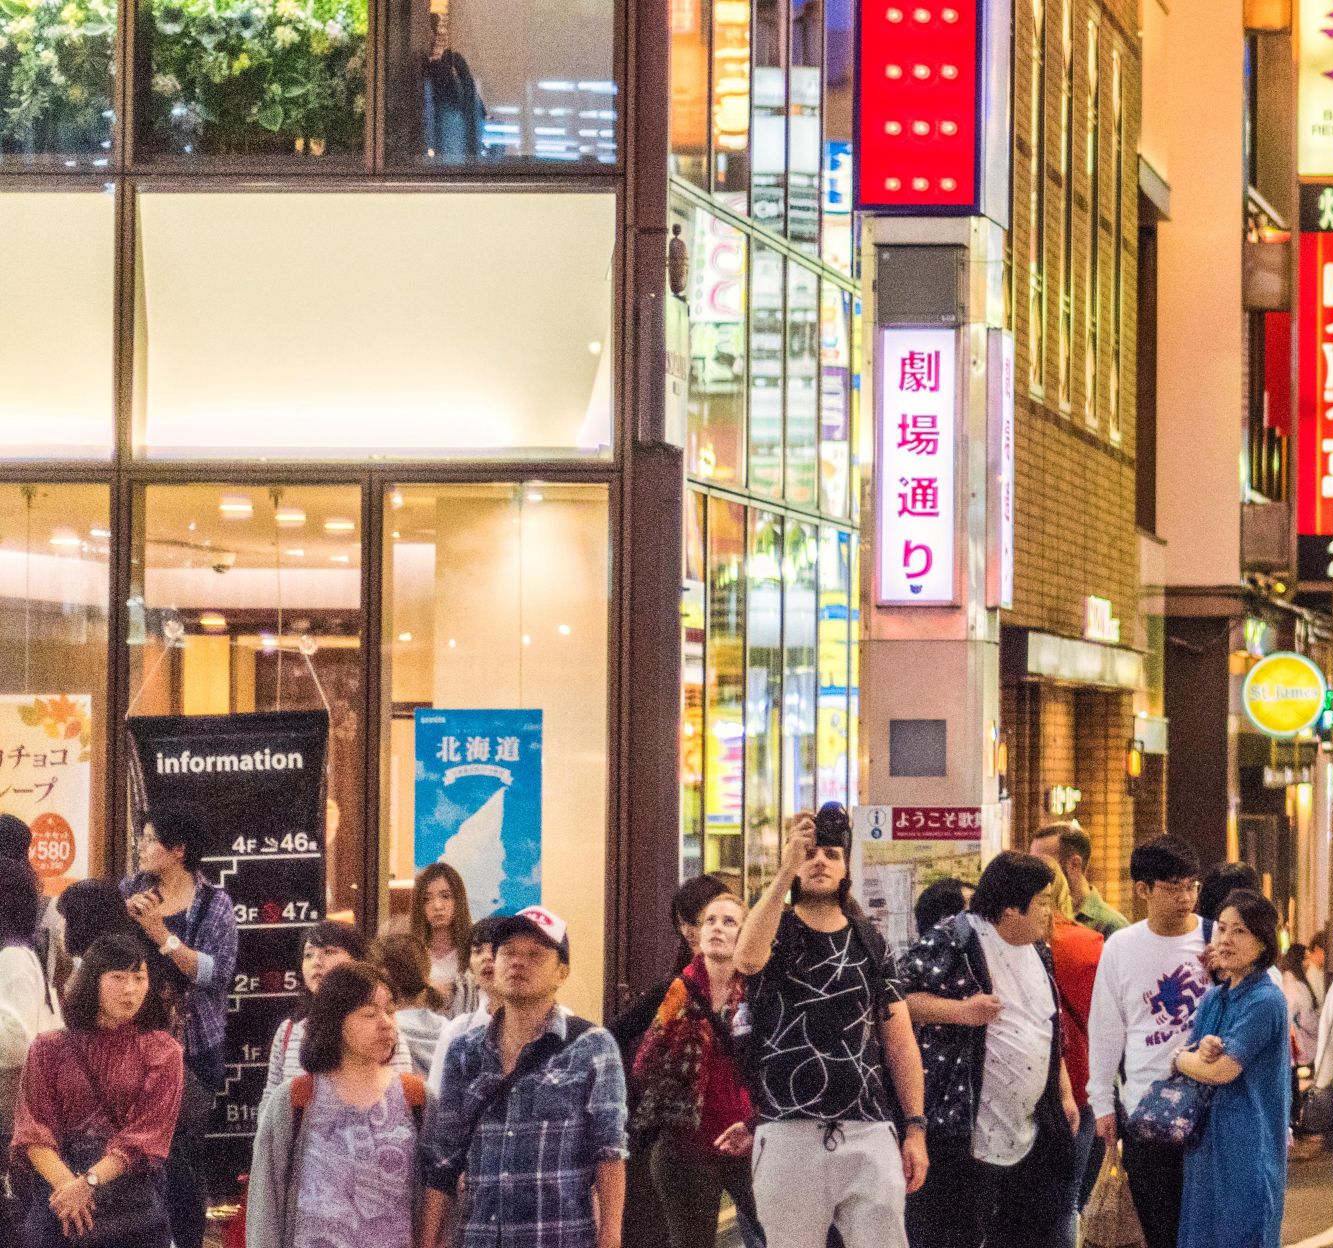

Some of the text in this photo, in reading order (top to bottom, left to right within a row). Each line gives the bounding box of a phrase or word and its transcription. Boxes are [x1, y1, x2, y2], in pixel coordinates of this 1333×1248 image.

[896, 349, 941, 580] 劇場通り
[0, 744, 68, 770] チョコ
[436, 735, 521, 762] 北海道
[156, 748, 304, 775] information
[231, 835, 257, 854] 4F
[233, 903, 259, 924] 3F
[233, 973, 261, 993] 2F
[241, 1043, 262, 1062] 1F
